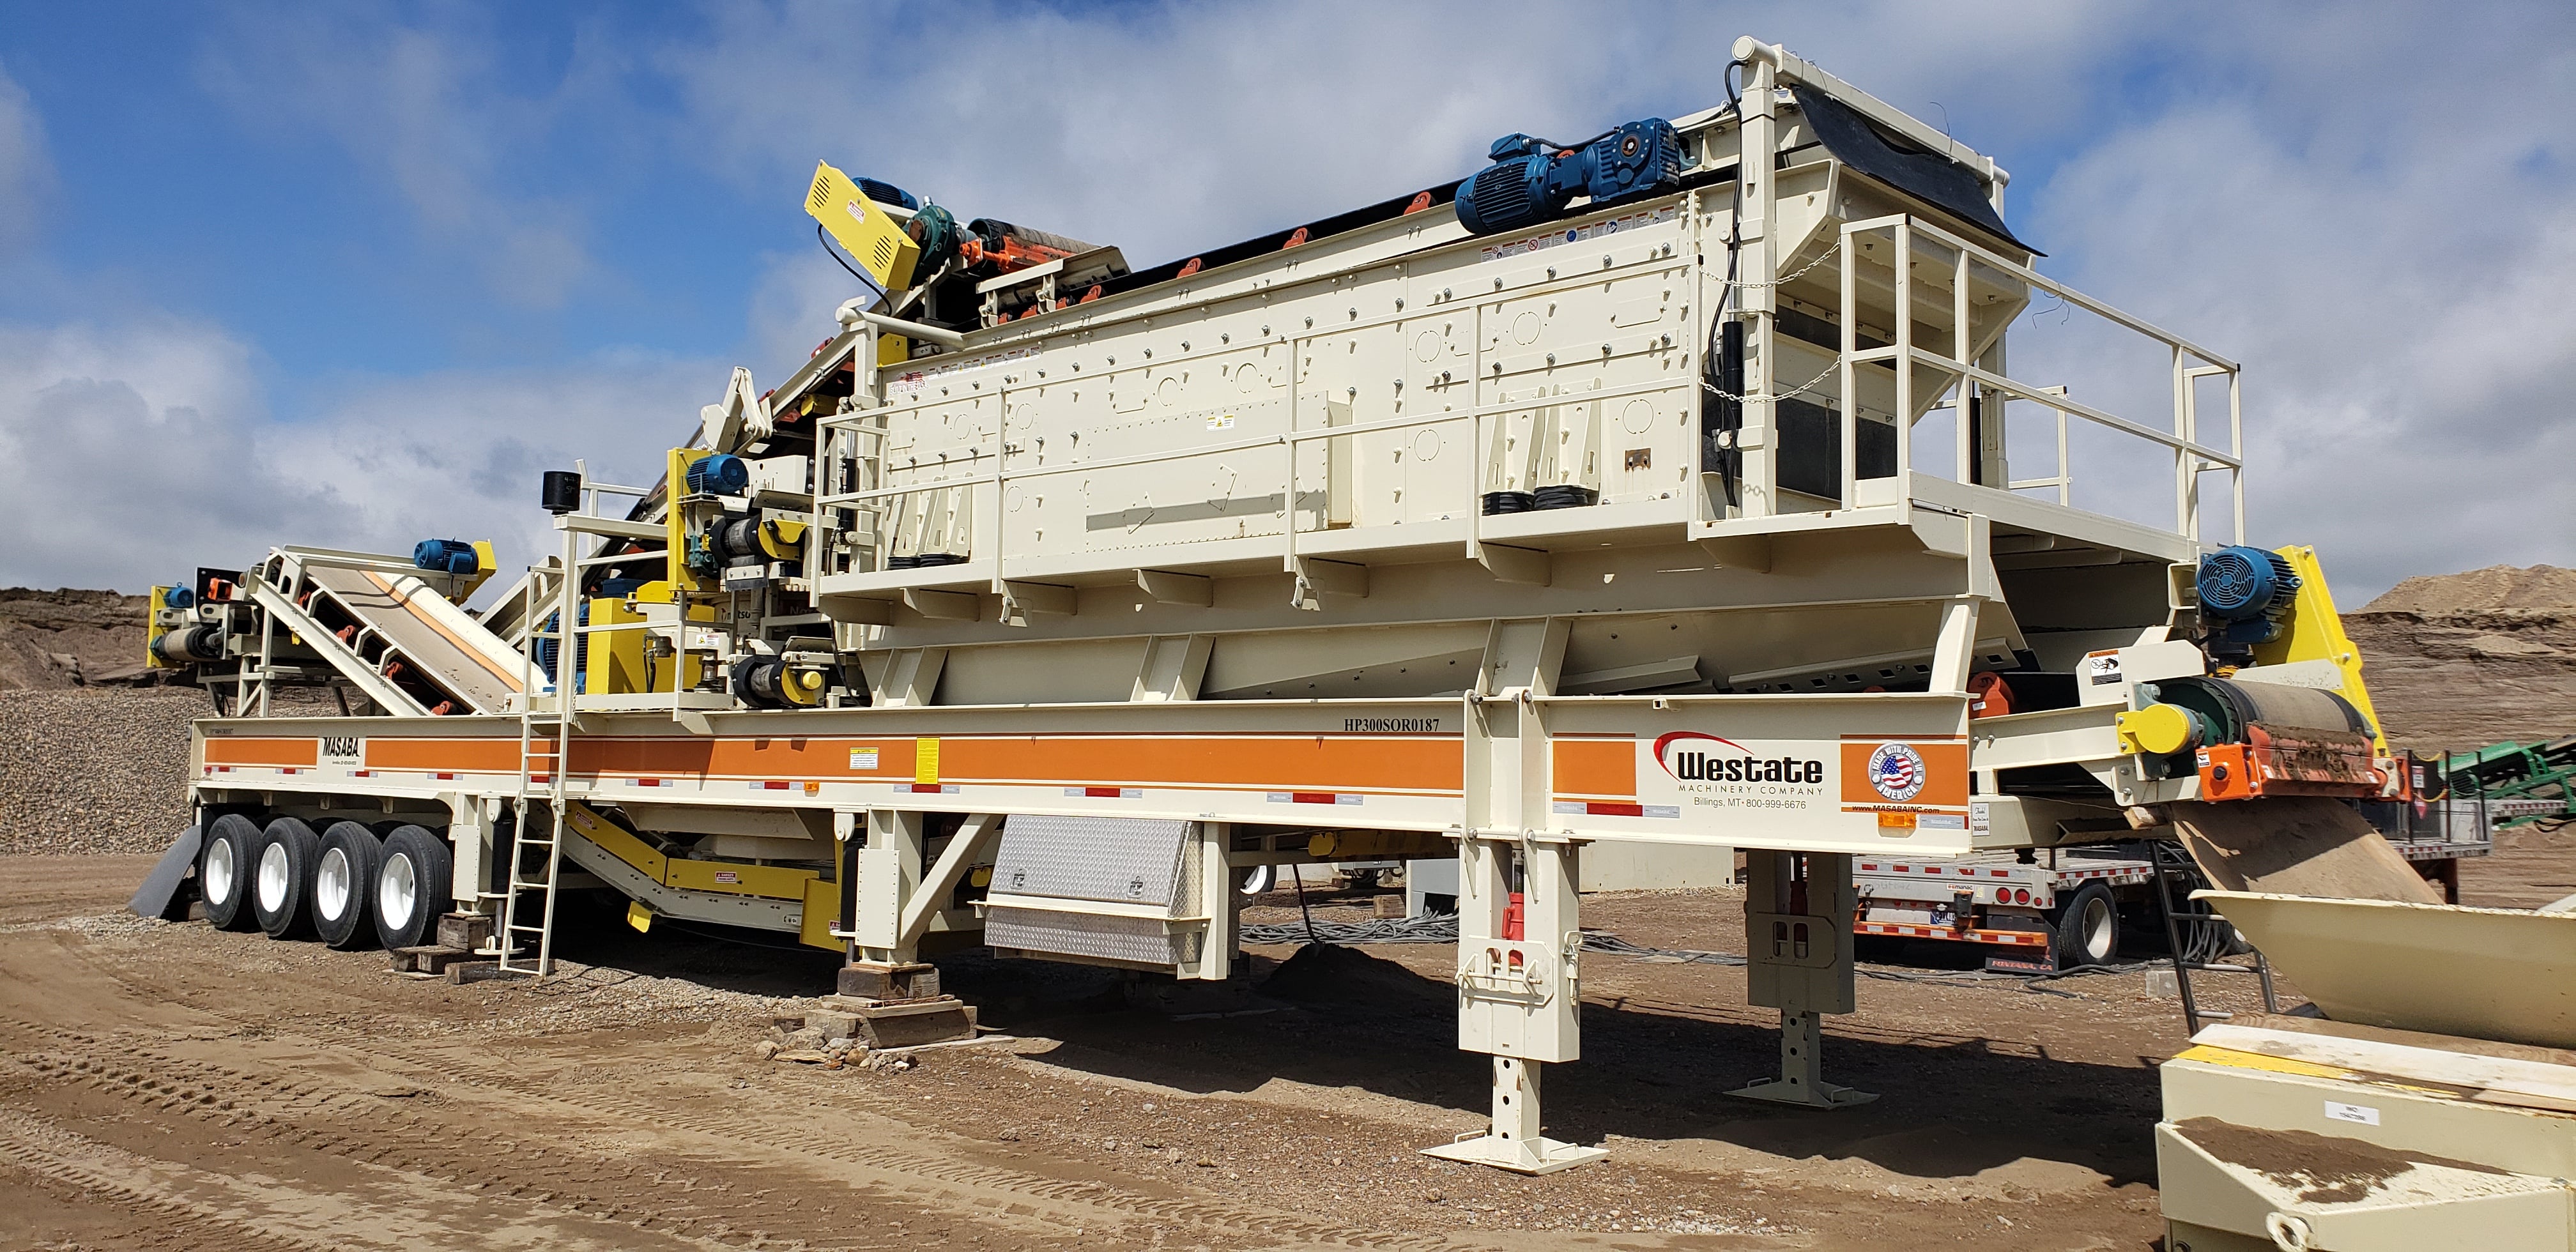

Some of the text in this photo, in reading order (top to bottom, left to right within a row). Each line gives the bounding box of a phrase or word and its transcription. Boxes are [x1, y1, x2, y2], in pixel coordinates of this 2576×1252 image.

[1344, 718, 1439, 732] HP300SOR0187
[322, 737, 361, 758] MASABA
[1873, 751, 1887, 770] MADE
[1885, 745, 1902, 754] WITH
[1903, 747, 1919, 764] PRIDE
[1677, 752, 1823, 784] Westate
[1678, 784, 1823, 796] MACHINERY COMPANY
[1876, 784, 1919, 800] AMERICA
[1694, 797, 1725, 808] Billings,
[1746, 799, 1806, 809] 800-999-6676
[1852, 805, 1940, 814] www.MASABAINC.com
